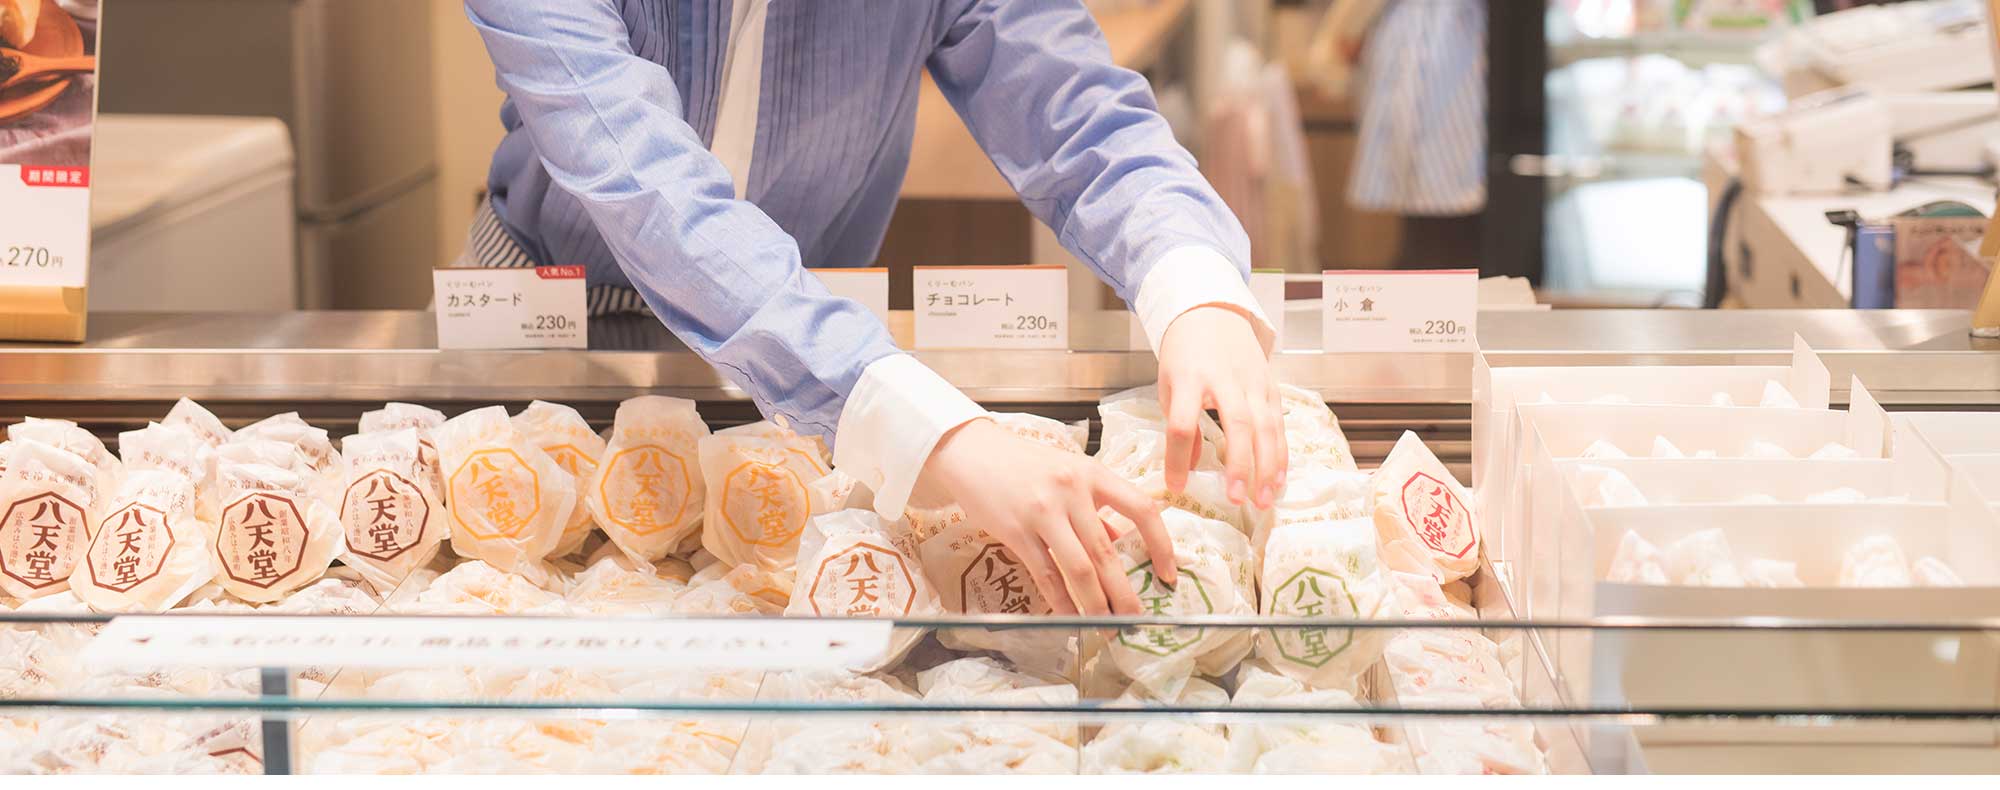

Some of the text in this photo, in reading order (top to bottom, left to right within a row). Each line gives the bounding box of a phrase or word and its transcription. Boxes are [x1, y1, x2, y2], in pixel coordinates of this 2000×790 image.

[447, 293, 523, 308] カスタード
[536, 315, 577, 330] 230円
[927, 293, 1014, 307] チョコレート
[1016, 315, 1057, 331] 230円
[1424, 319, 1466, 335] 230円
[364, 475, 401, 555] 八天堂
[470, 456, 523, 534] 八天堂
[631, 451, 665, 528] 八天堂
[748, 466, 788, 541] 八天堂
[1423, 486, 1456, 551] 八天堂
[23, 500, 66, 581] 八天堂
[112, 508, 147, 586] 八天堂
[241, 499, 281, 581] 八天堂
